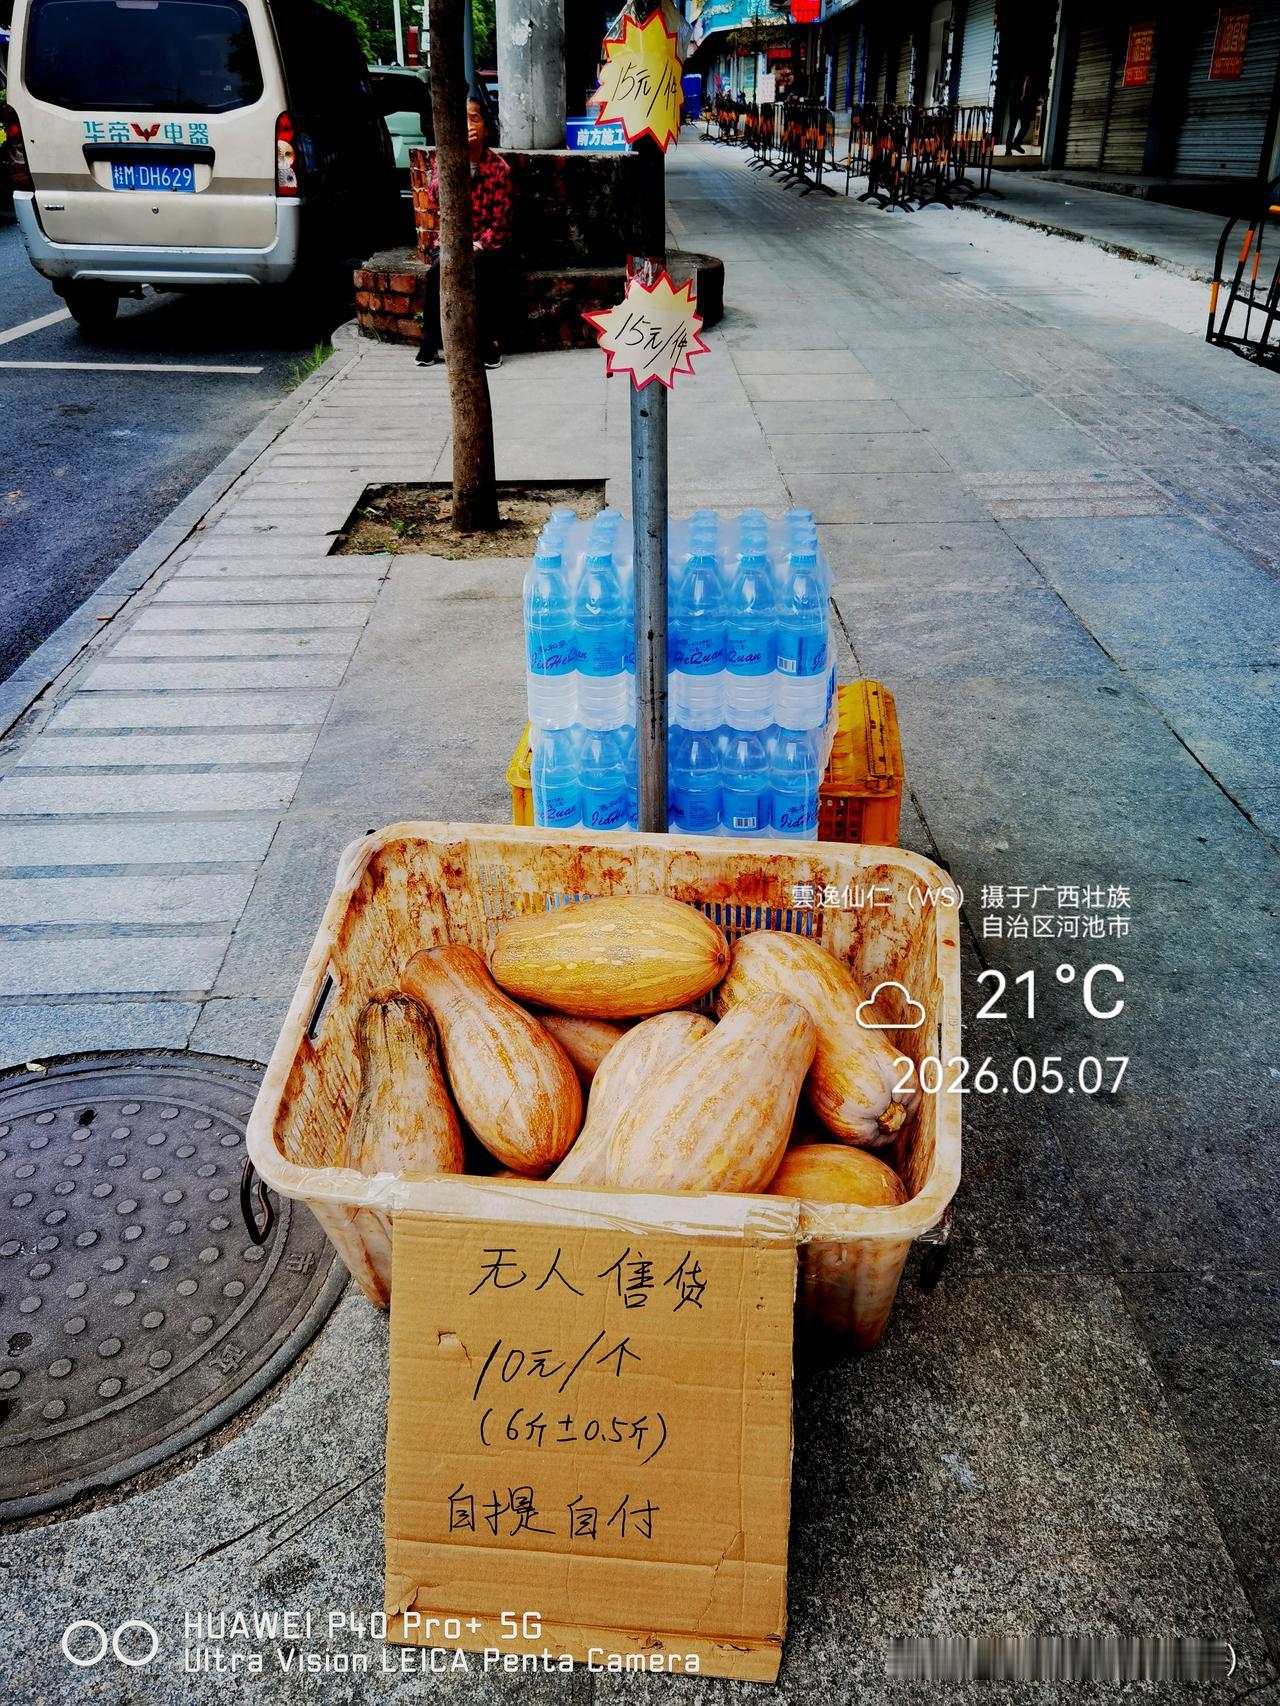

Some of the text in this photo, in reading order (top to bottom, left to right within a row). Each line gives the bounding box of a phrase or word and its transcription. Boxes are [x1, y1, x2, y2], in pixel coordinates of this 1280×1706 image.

[83, 121, 209, 144] 华帝 电器
[577, 128, 625, 146] 前方施工
[614, 313, 688, 369] 15元/件
[469, 1247, 708, 1311] 无人售货
[473, 1330, 642, 1400] 10元/个
[447, 1483, 660, 1540] 自提自付
